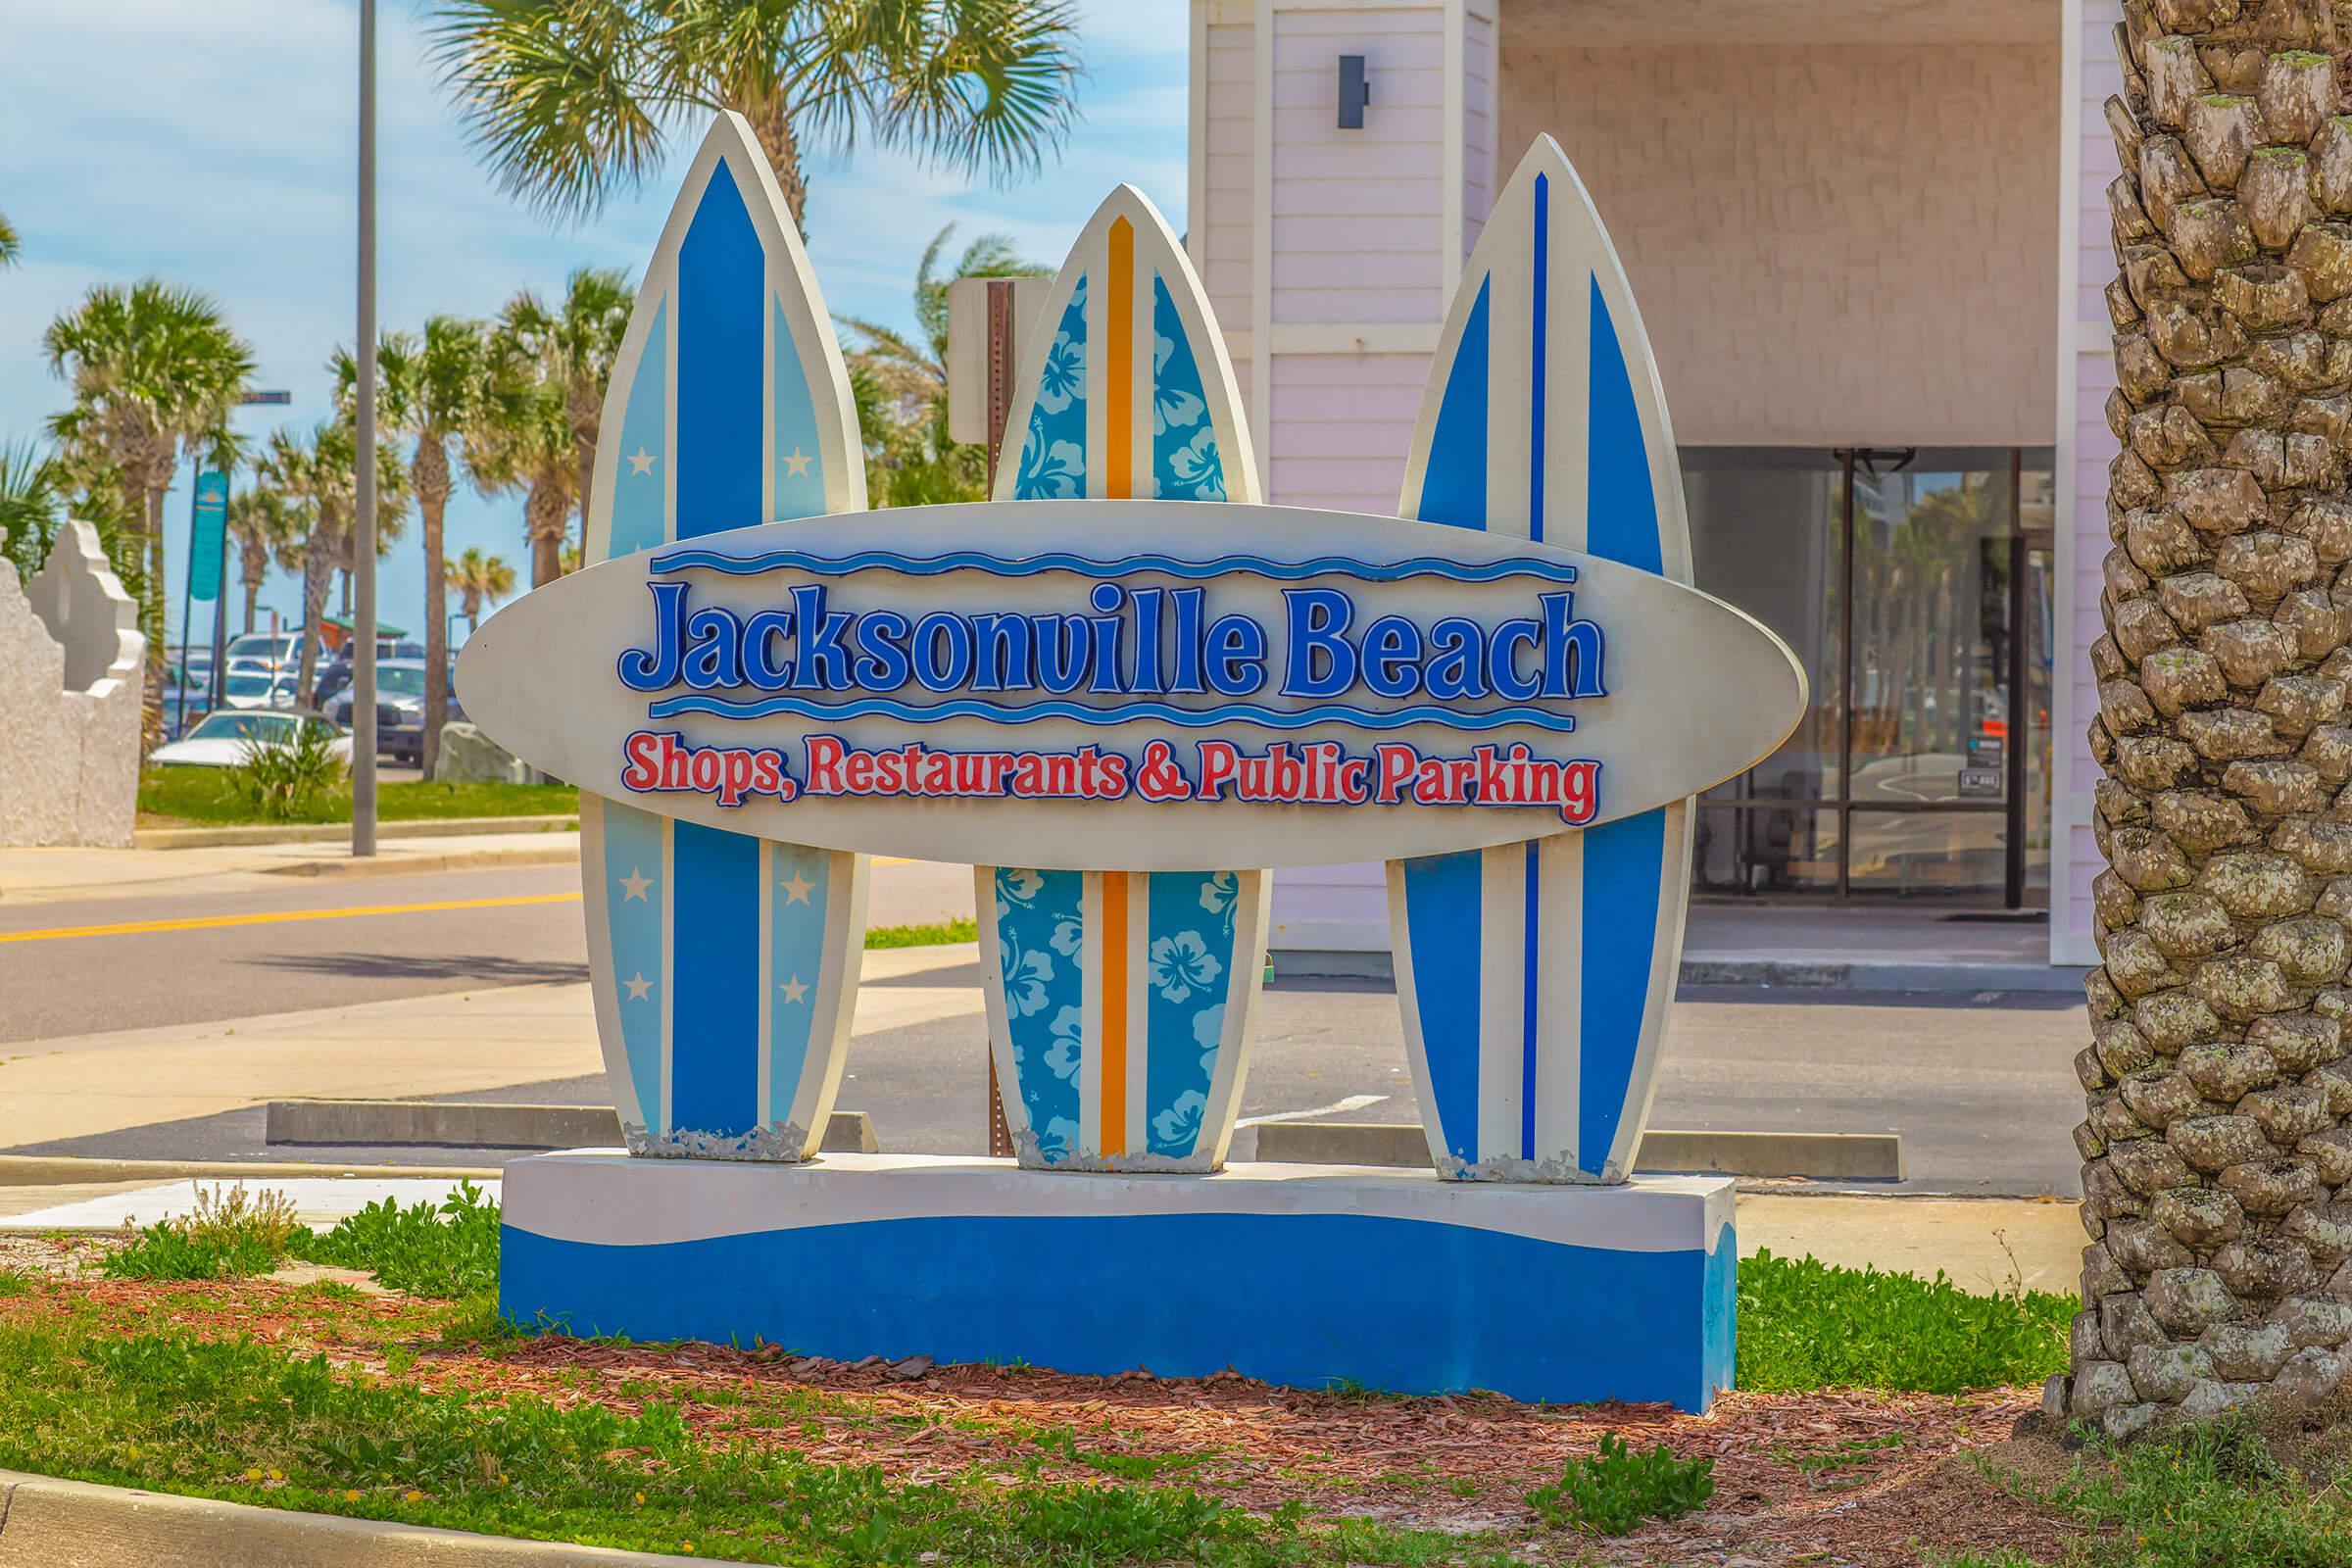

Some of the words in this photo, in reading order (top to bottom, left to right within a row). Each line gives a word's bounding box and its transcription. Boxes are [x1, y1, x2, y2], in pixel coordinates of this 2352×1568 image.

[617, 580, 1268, 695] Jacksonville
[1279, 588, 1608, 701] Beach
[621, 730, 800, 808] Shops,
[803, 733, 1130, 802] Restaurants
[1135, 739, 1190, 805] &
[1195, 740, 1373, 806] Public
[1373, 742, 1602, 826] Parking
